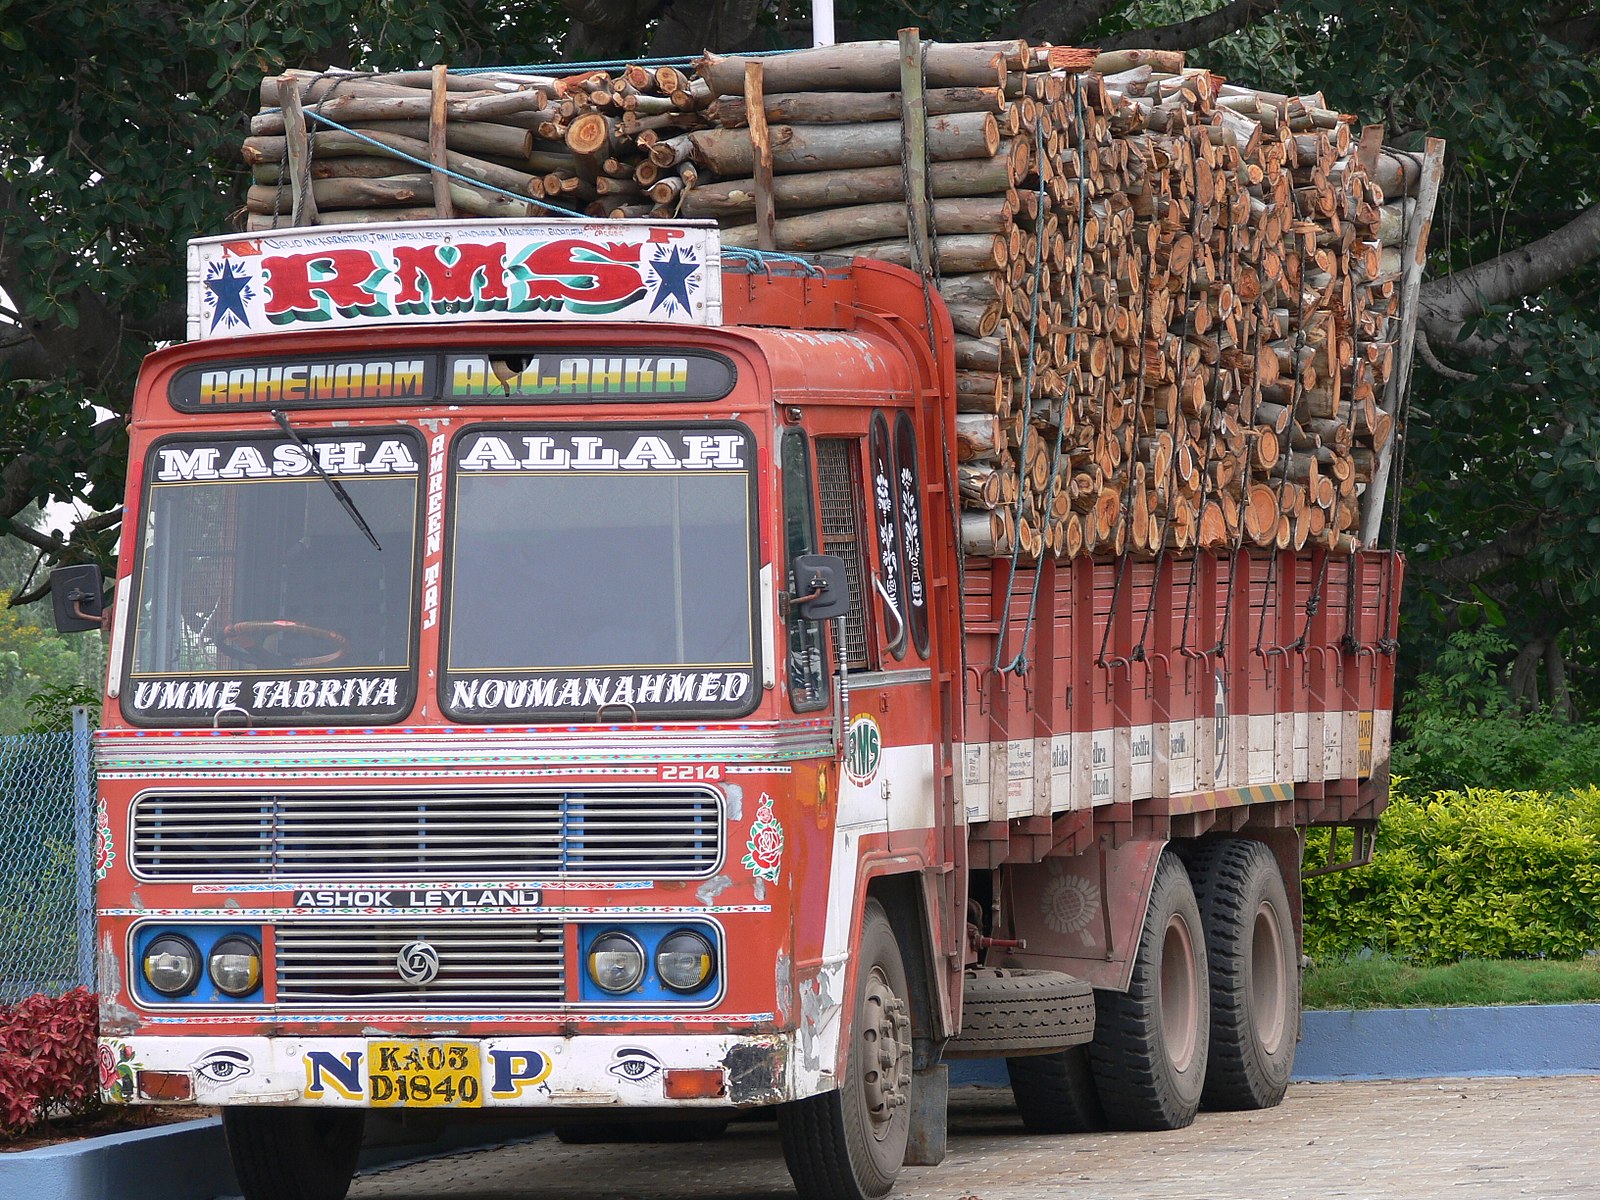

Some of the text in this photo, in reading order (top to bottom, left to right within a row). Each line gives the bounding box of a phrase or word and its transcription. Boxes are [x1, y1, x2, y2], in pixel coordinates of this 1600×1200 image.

[262, 238, 647, 325] RMS
[158, 435, 744, 481] MASHA ALLAH
[423, 434, 445, 630] AMREEN TAJ
[133, 676, 398, 710] UMME TABRIYA
[661, 765, 721, 780] 2214
[295, 890, 540, 907] ASHOK LEYLAND
[303, 1050, 364, 1098] N
[489, 1050, 551, 1097] P
